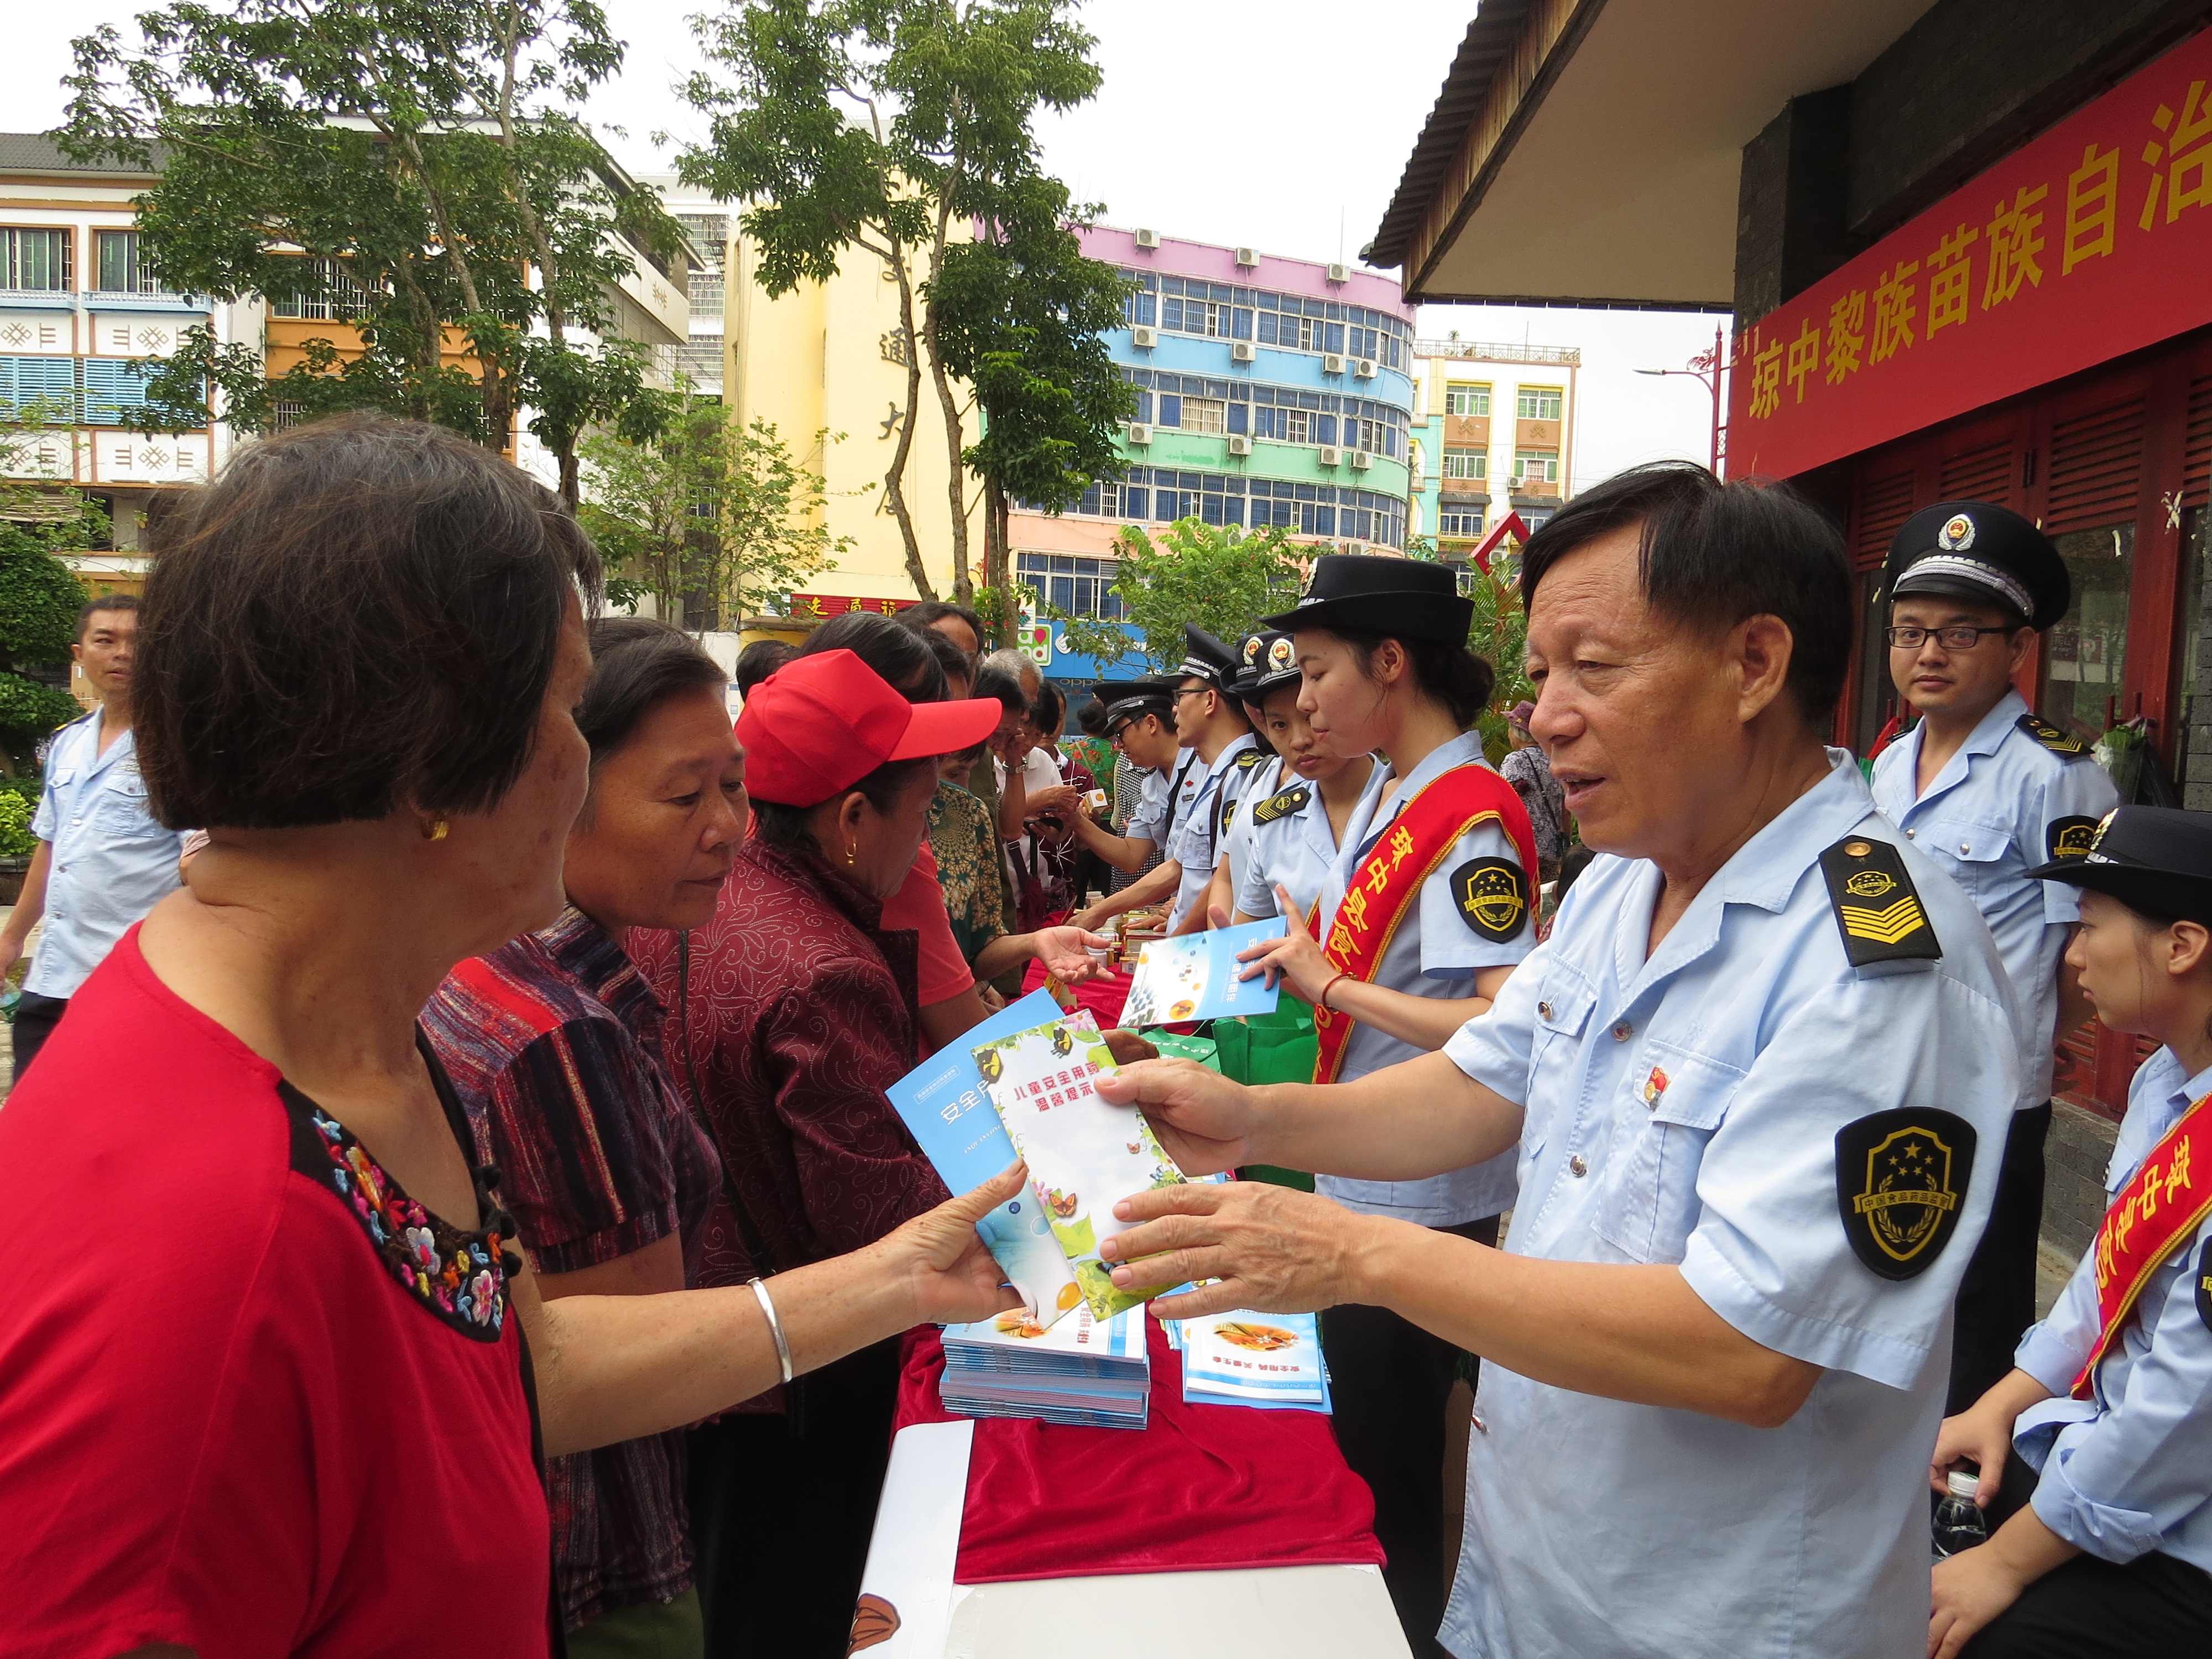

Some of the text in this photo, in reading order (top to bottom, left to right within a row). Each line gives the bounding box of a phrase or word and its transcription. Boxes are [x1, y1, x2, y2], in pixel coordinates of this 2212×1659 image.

[1749, 80, 2212, 420] 琼中黎族苗族自治
[1014, 1061, 1101, 1101] 儿童安全用药
[1034, 1081, 1094, 1112] 温馨提示
